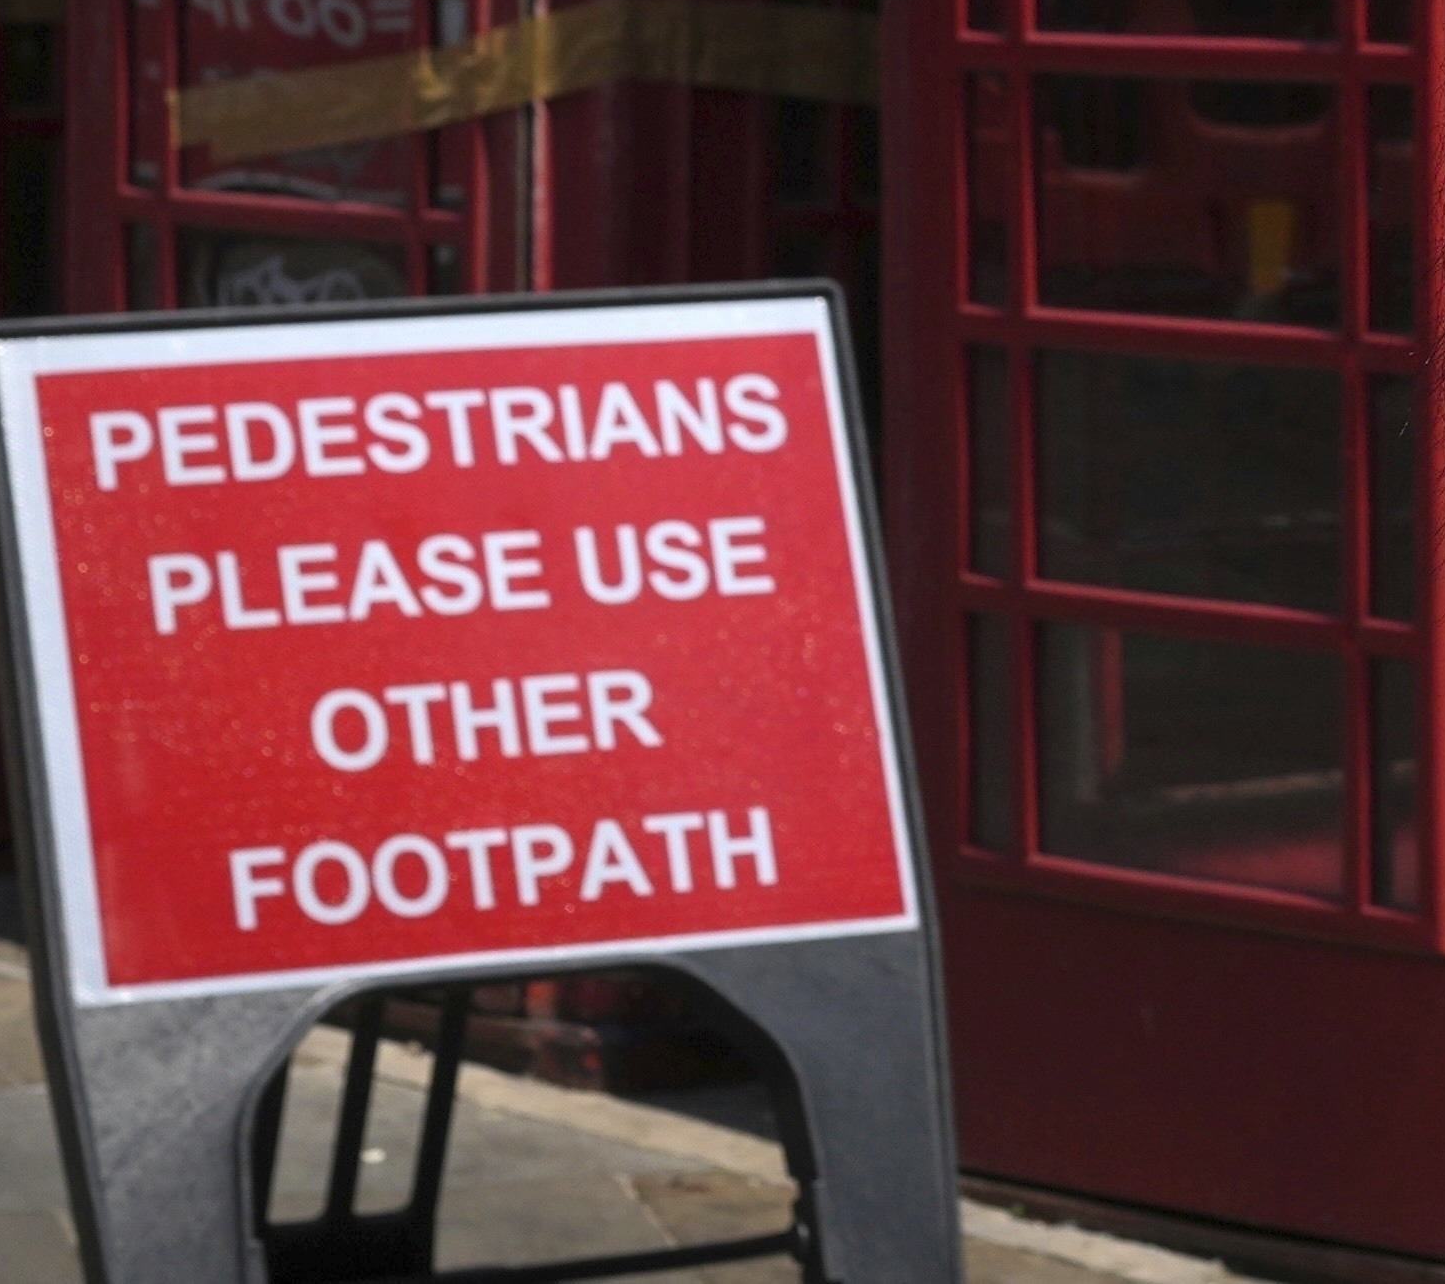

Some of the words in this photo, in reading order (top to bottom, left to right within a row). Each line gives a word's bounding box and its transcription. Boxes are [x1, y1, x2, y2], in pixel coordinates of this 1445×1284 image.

[88, 373, 788, 491] PEDESTRIANS
[148, 530, 551, 634] PLEASE
[573, 516, 775, 605] USE
[310, 668, 663, 772] OTHER
[229, 807, 780, 931] FOOTPATH
